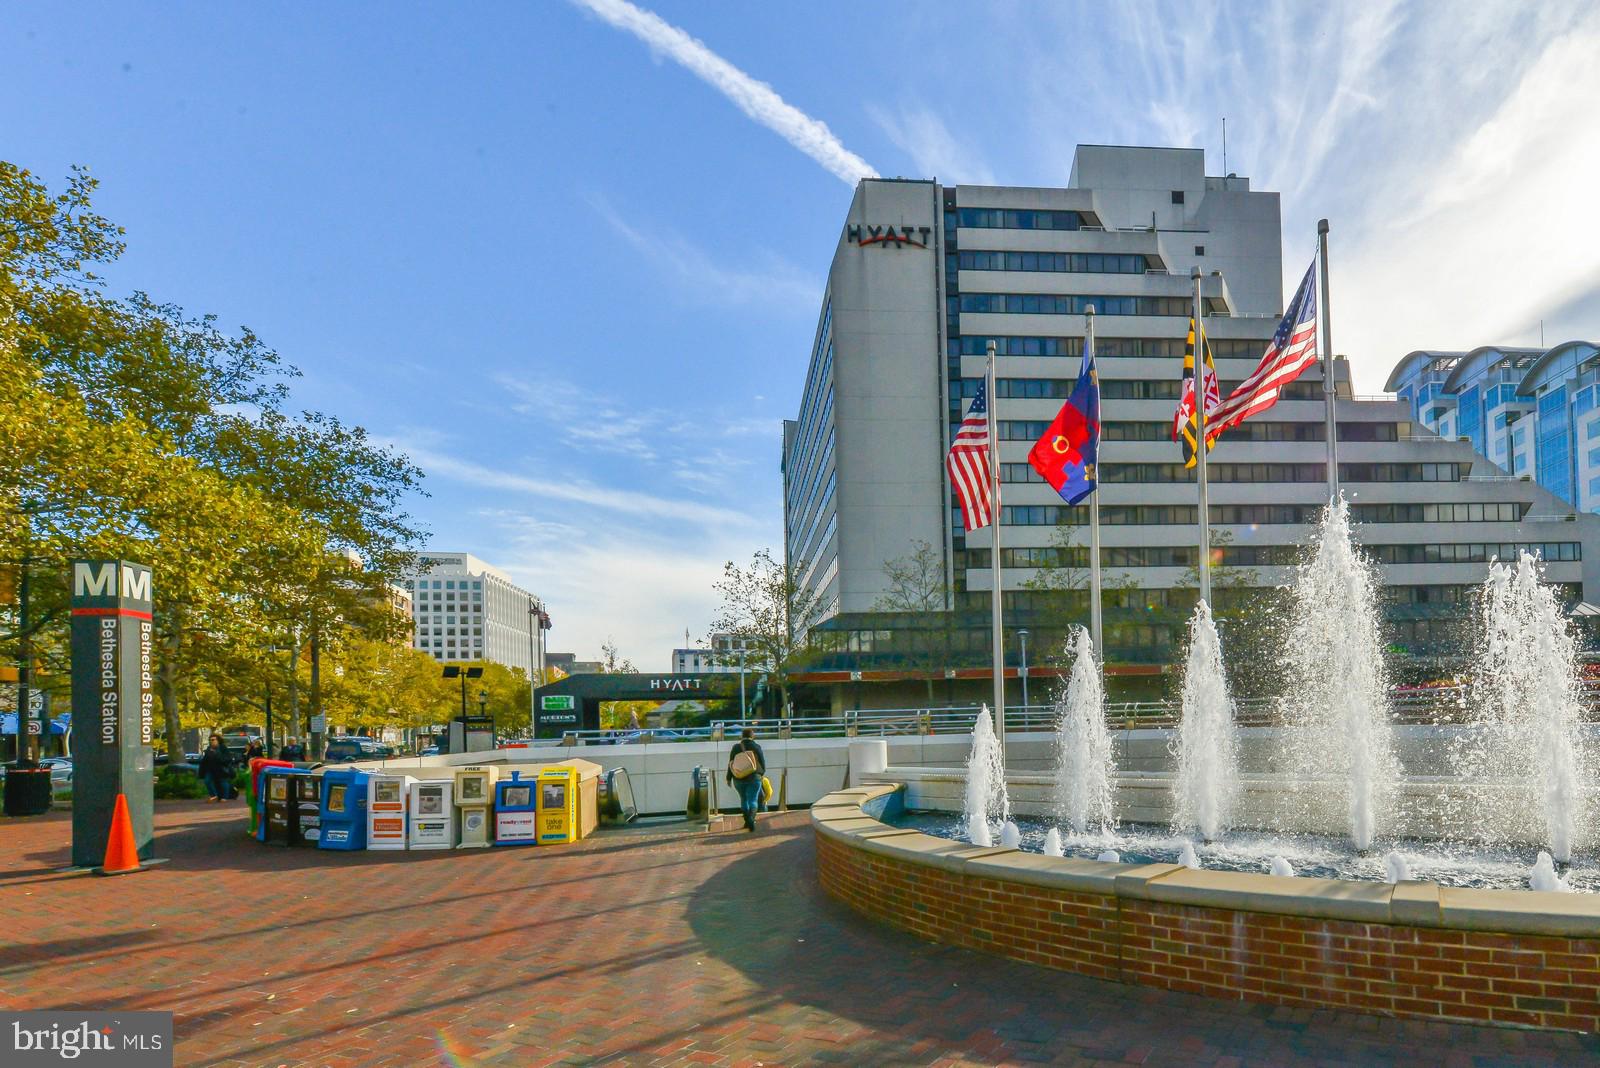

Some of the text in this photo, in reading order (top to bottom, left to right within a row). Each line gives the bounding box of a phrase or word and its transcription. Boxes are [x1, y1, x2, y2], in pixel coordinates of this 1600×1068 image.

[847, 224, 931, 249] HYATT
[74, 563, 117, 597] M
[122, 566, 151, 602] M
[101, 618, 118, 745] Bethesda Station
[141, 622, 153, 744] Bethesda Station
[650, 679, 702, 691] HYATT
[545, 817, 563, 825] take
